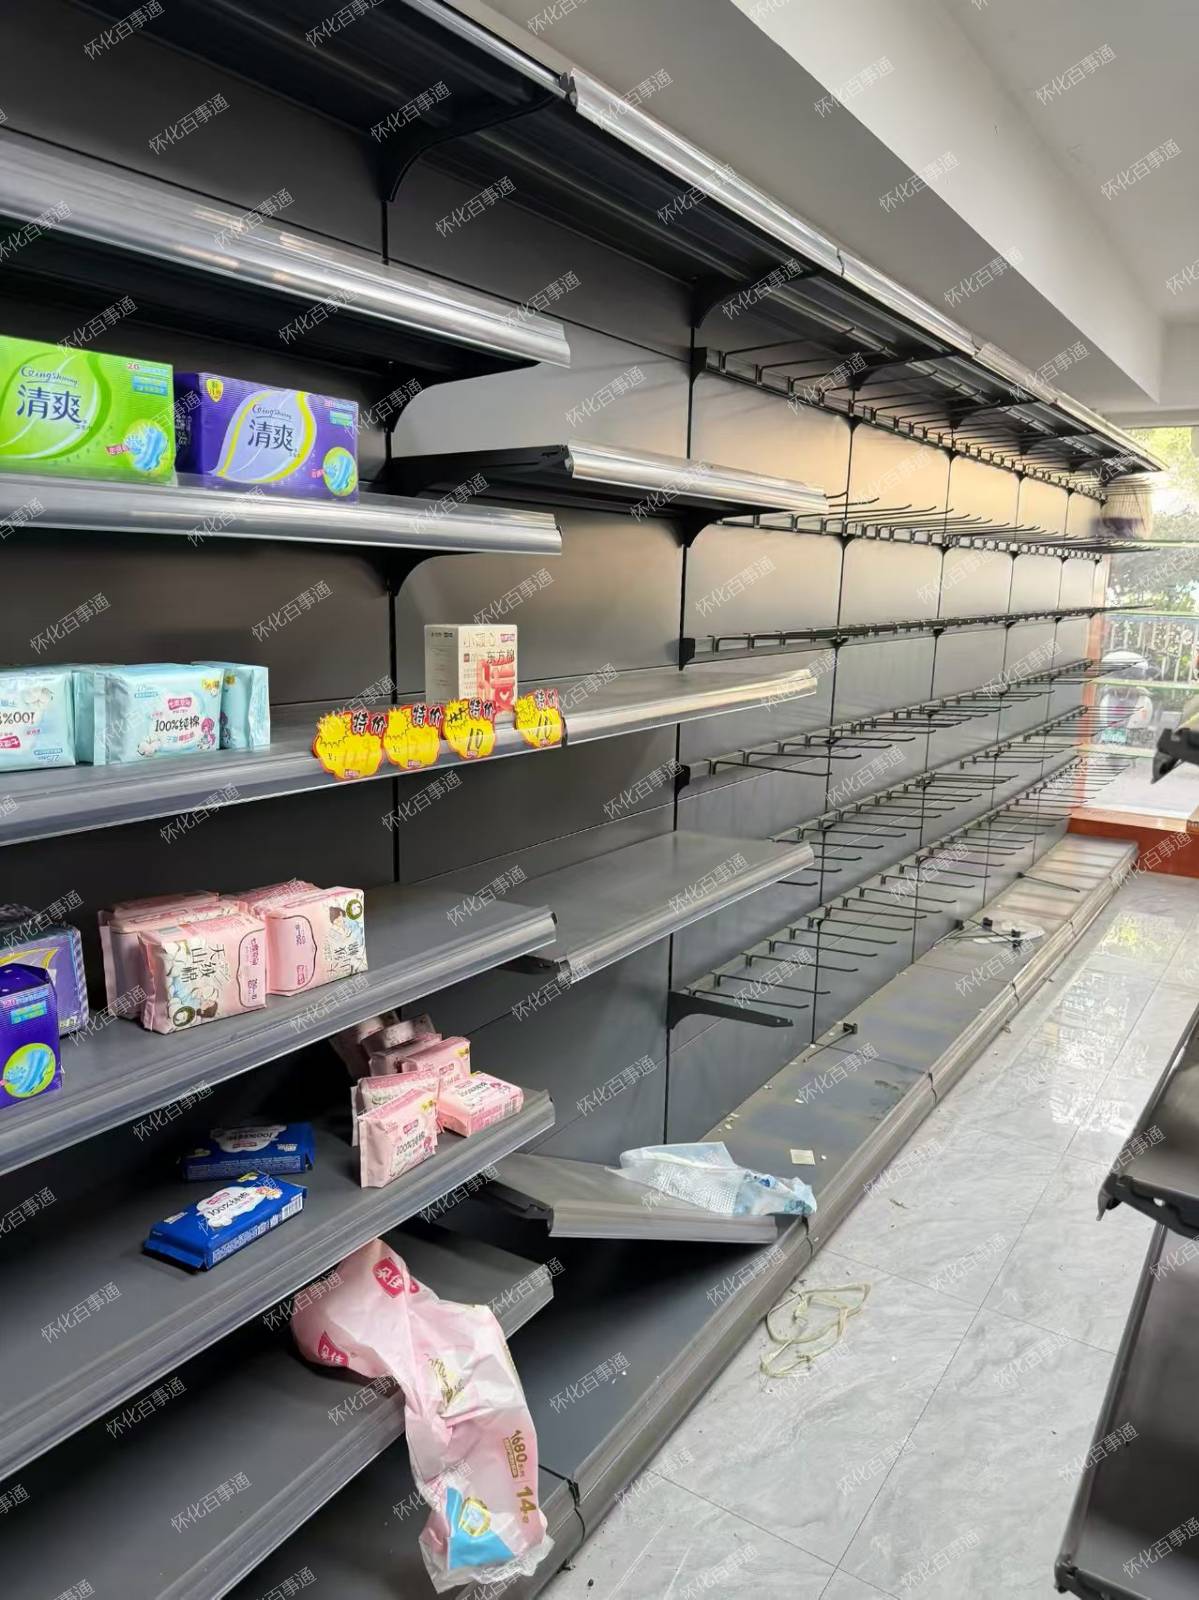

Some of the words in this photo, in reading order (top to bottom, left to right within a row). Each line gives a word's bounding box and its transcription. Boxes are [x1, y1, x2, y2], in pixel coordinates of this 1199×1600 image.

[16, 384, 83, 424] 清爽
[248, 418, 295, 452] 清爽
[470, 698, 493, 720] 特价
[537, 689, 557, 709] 特价
[0, 711, 35, 725] 100%
[154, 715, 200, 732] 100%纯棉
[353, 711, 386, 737] 特价
[413, 704, 441, 728] 特价
[467, 728, 484, 751] 10
